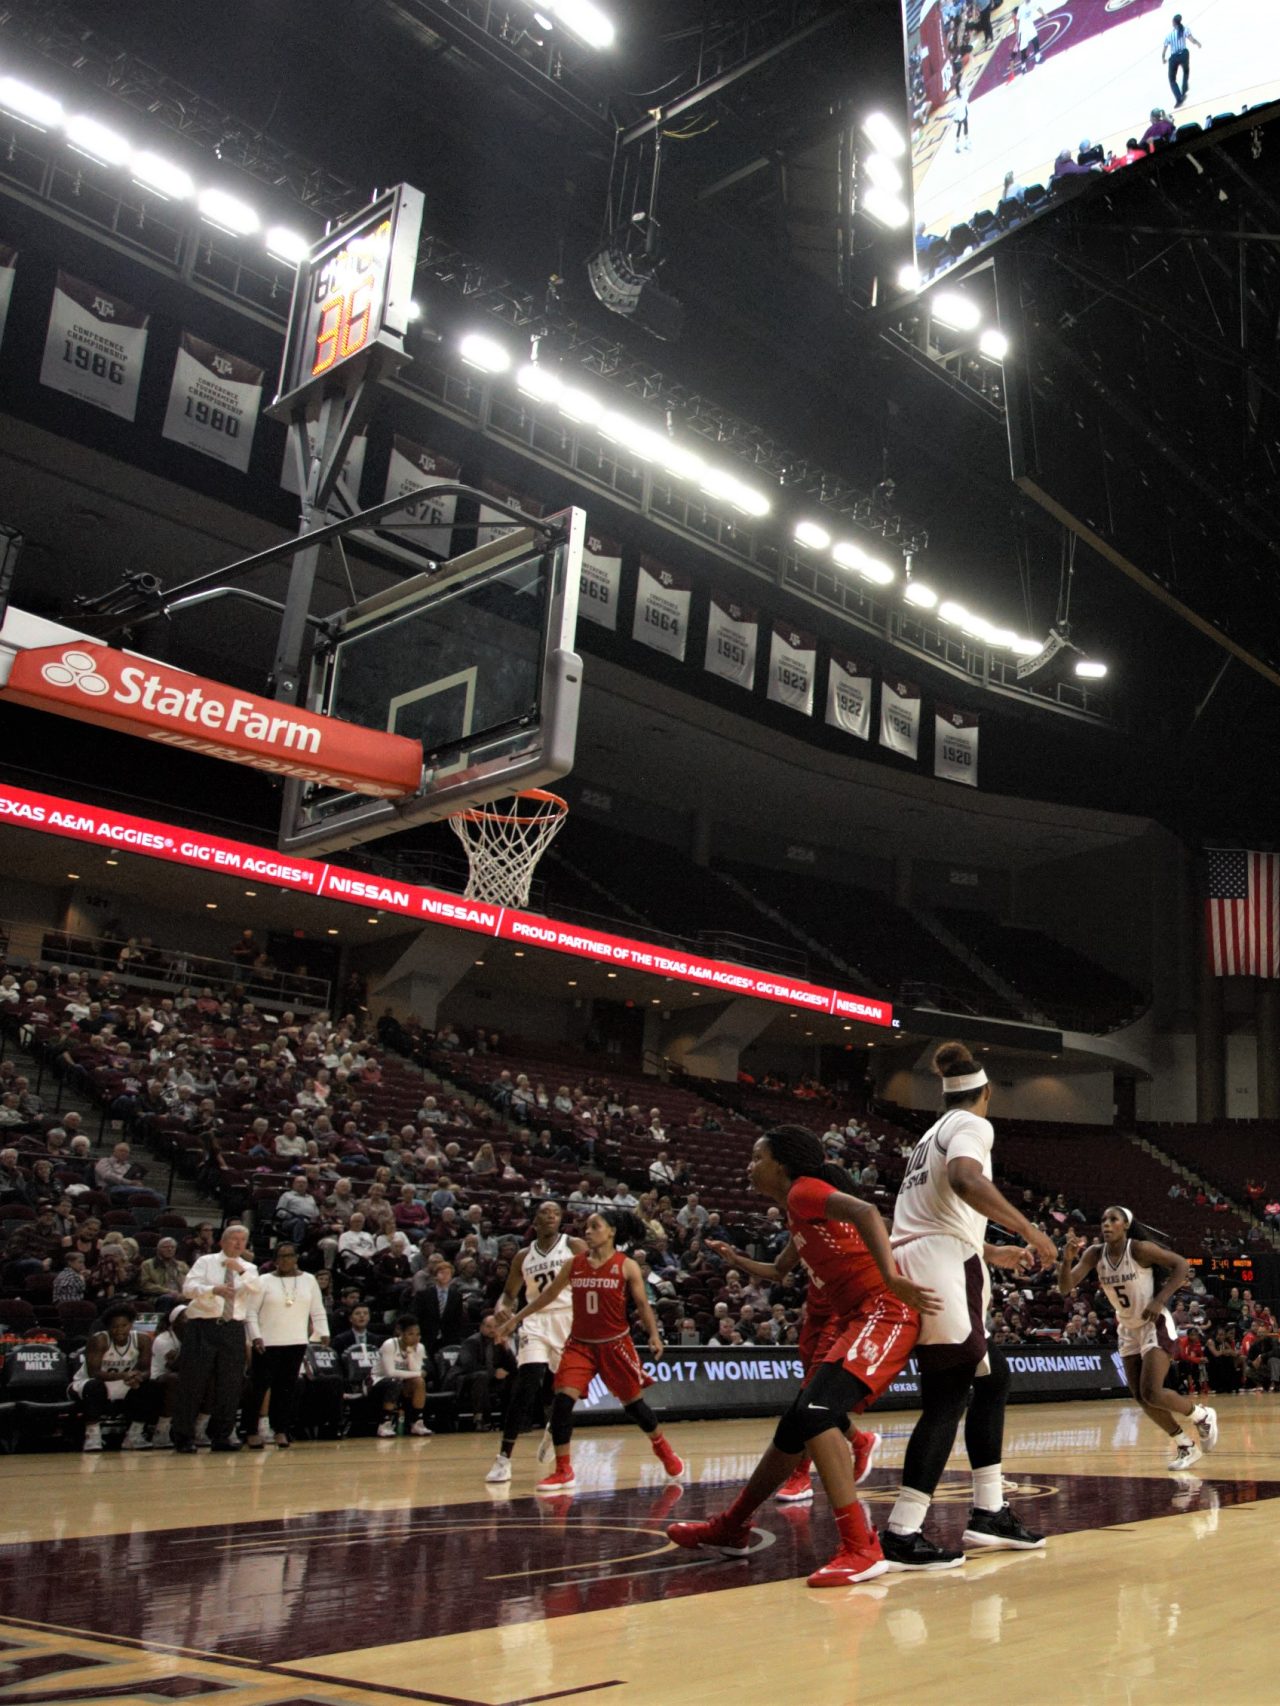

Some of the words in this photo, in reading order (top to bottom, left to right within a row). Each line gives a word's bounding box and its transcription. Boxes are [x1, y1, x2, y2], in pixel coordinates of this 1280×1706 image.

[67, 330, 128, 362] CHAMPIONSHIP
[73, 324, 124, 352] CONFERENCE
[62, 339, 126, 385] 1986
[188, 386, 243, 415] CHAMPIONSHIP
[195, 382, 239, 407] TOURNAMENT
[198, 377, 239, 400] CONFERENCE
[184, 395, 239, 438] 1980
[404, 502, 444, 525] 976
[580, 575, 609, 604] 969
[645, 605, 679, 635] 1964
[718, 638, 746, 665] 1951
[778, 665, 807, 692] 1923
[943, 746, 971, 766] 1920
[48, 811, 94, 833] A&M
[329, 876, 409, 907] NISSAN
[422, 898, 494, 927] NISSAN
[512, 922, 556, 942] PROUD
[558, 934, 612, 957] PARTNER
[613, 947, 629, 959] OF
[630, 951, 652, 966] THE
[653, 957, 687, 975] TEXAS
[688, 966, 712, 980] A&M
[836, 998, 882, 1019] NISSAN
[526, 1262, 548, 1275] TEXAS
[571, 1278, 619, 1289] HOUSTON
[586, 1291, 599, 1314] 0
[1113, 1286, 1130, 1308] 5
[17, 1352, 59, 1361] MUSCLE
[25, 1362, 53, 1370] MILK
[646, 1361, 697, 1382] 2017
[704, 1360, 805, 1380] WOMEN'S
[1006, 1356, 1102, 1373] TOURNAMENT
